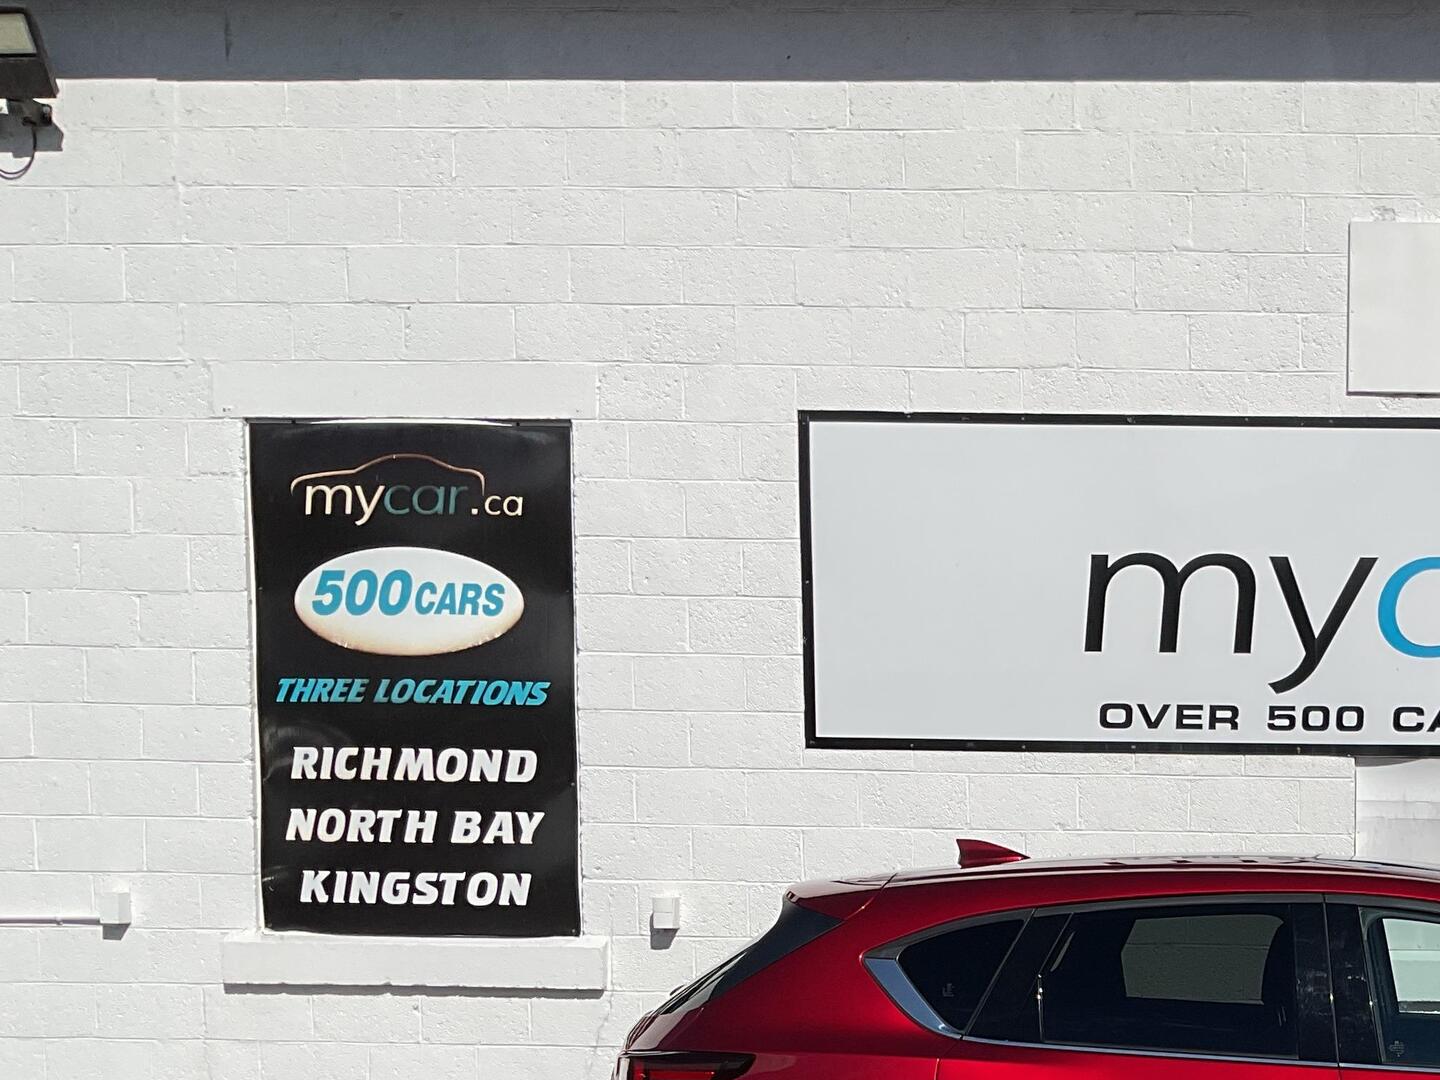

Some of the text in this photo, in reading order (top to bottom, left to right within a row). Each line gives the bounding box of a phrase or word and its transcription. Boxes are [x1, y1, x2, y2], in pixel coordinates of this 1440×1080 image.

[311, 569, 506, 617] 500 CARS
[275, 677, 552, 706] THREE LOCATIONS
[1099, 702, 1240, 731] OVER
[1267, 705, 1365, 732] 500
[290, 746, 538, 783] RICHMOND
[285, 807, 546, 845] NORTH BAY
[299, 869, 533, 907] KINGSTON
